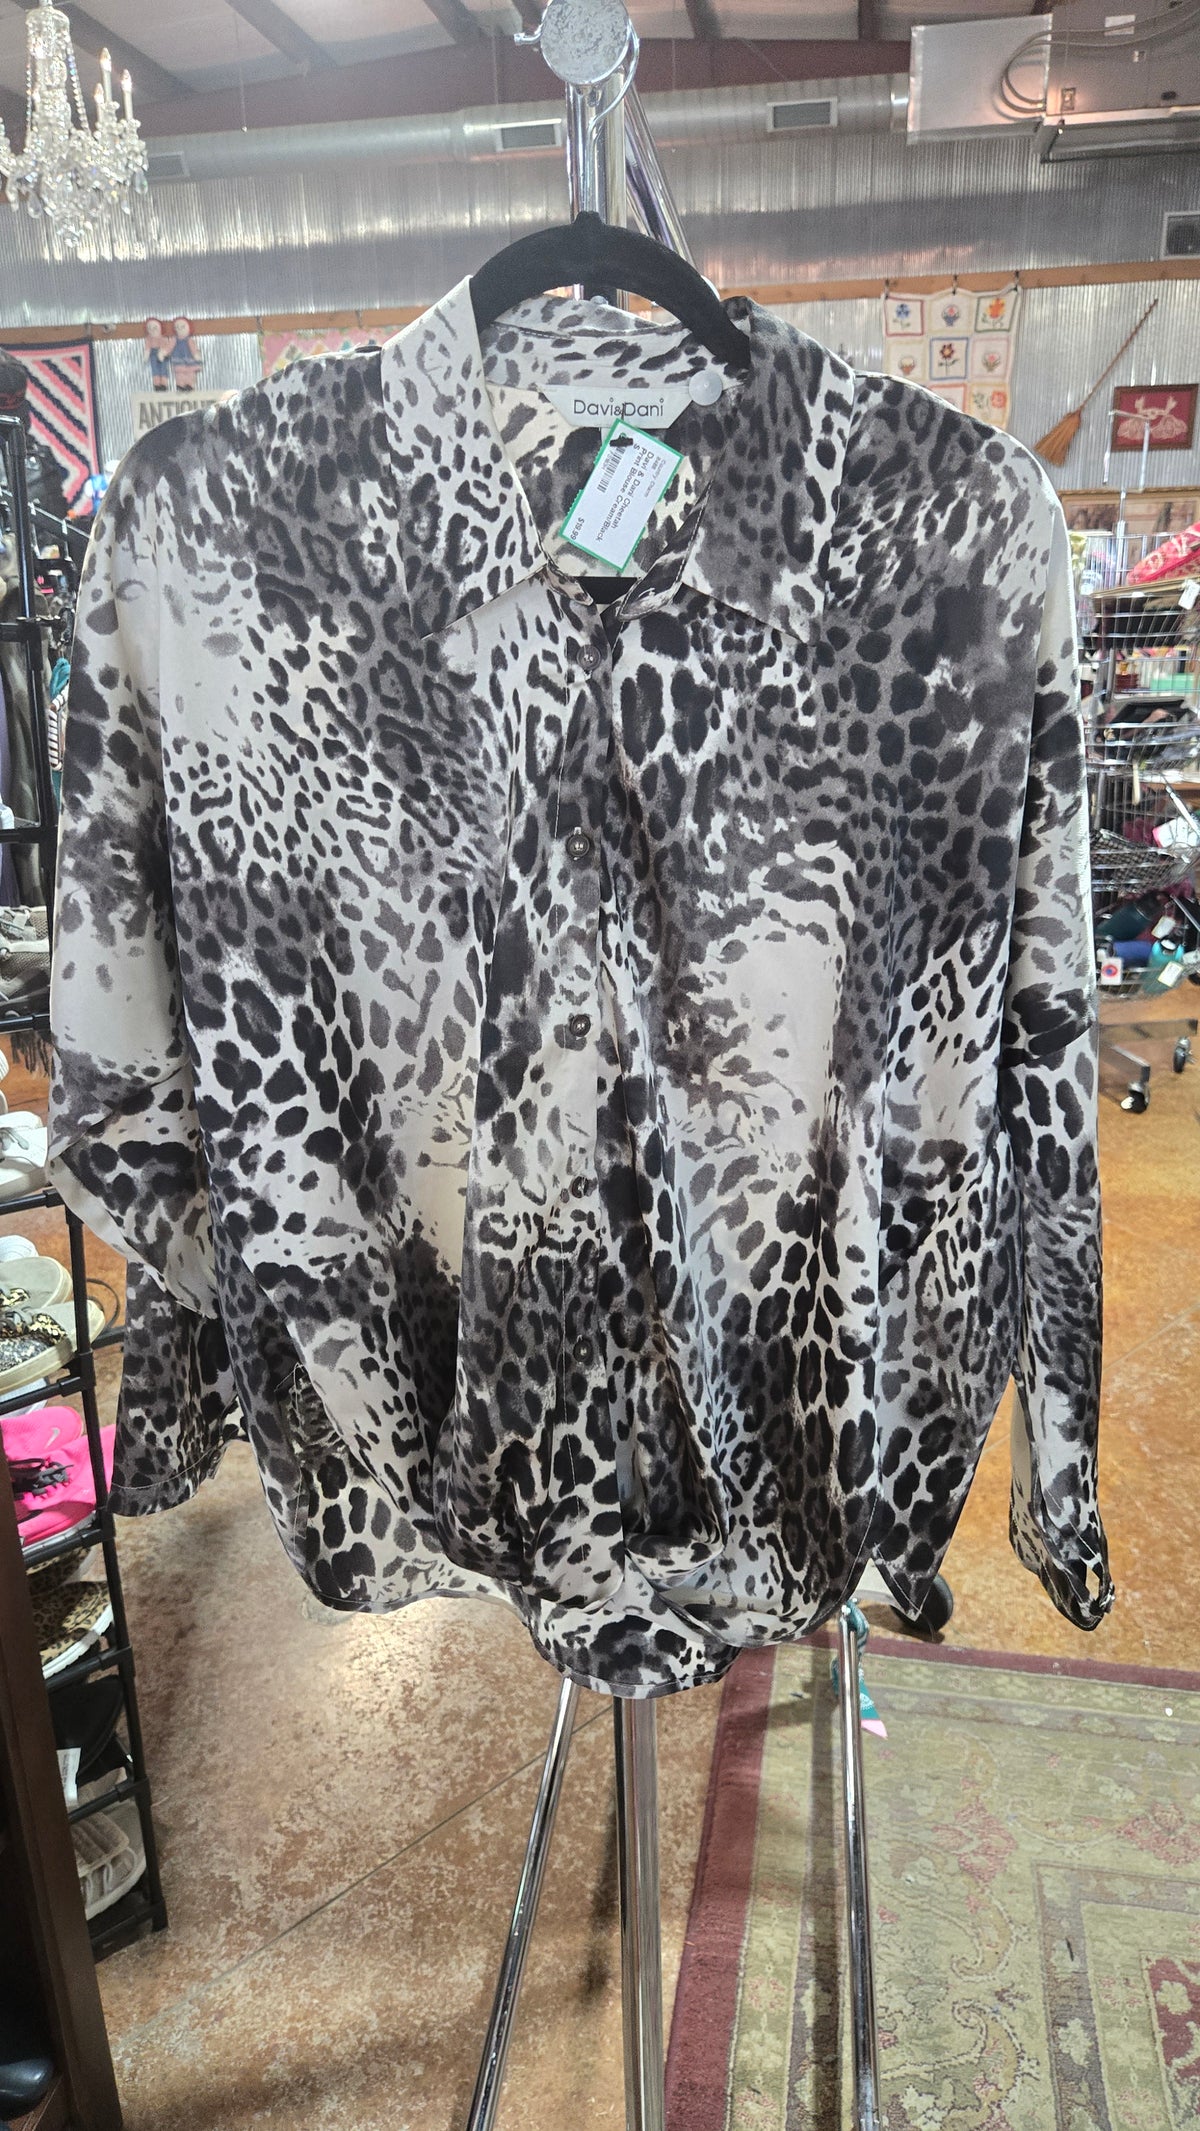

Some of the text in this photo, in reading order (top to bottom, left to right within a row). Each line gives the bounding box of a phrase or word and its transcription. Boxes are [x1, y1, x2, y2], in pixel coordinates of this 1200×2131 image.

[633, 442, 641, 450] S
[596, 447, 647, 541] Print Blouse Cream/Black
[611, 451, 655, 529] Davi & Dani Cheetah
[570, 516, 585, 540] $19.99
